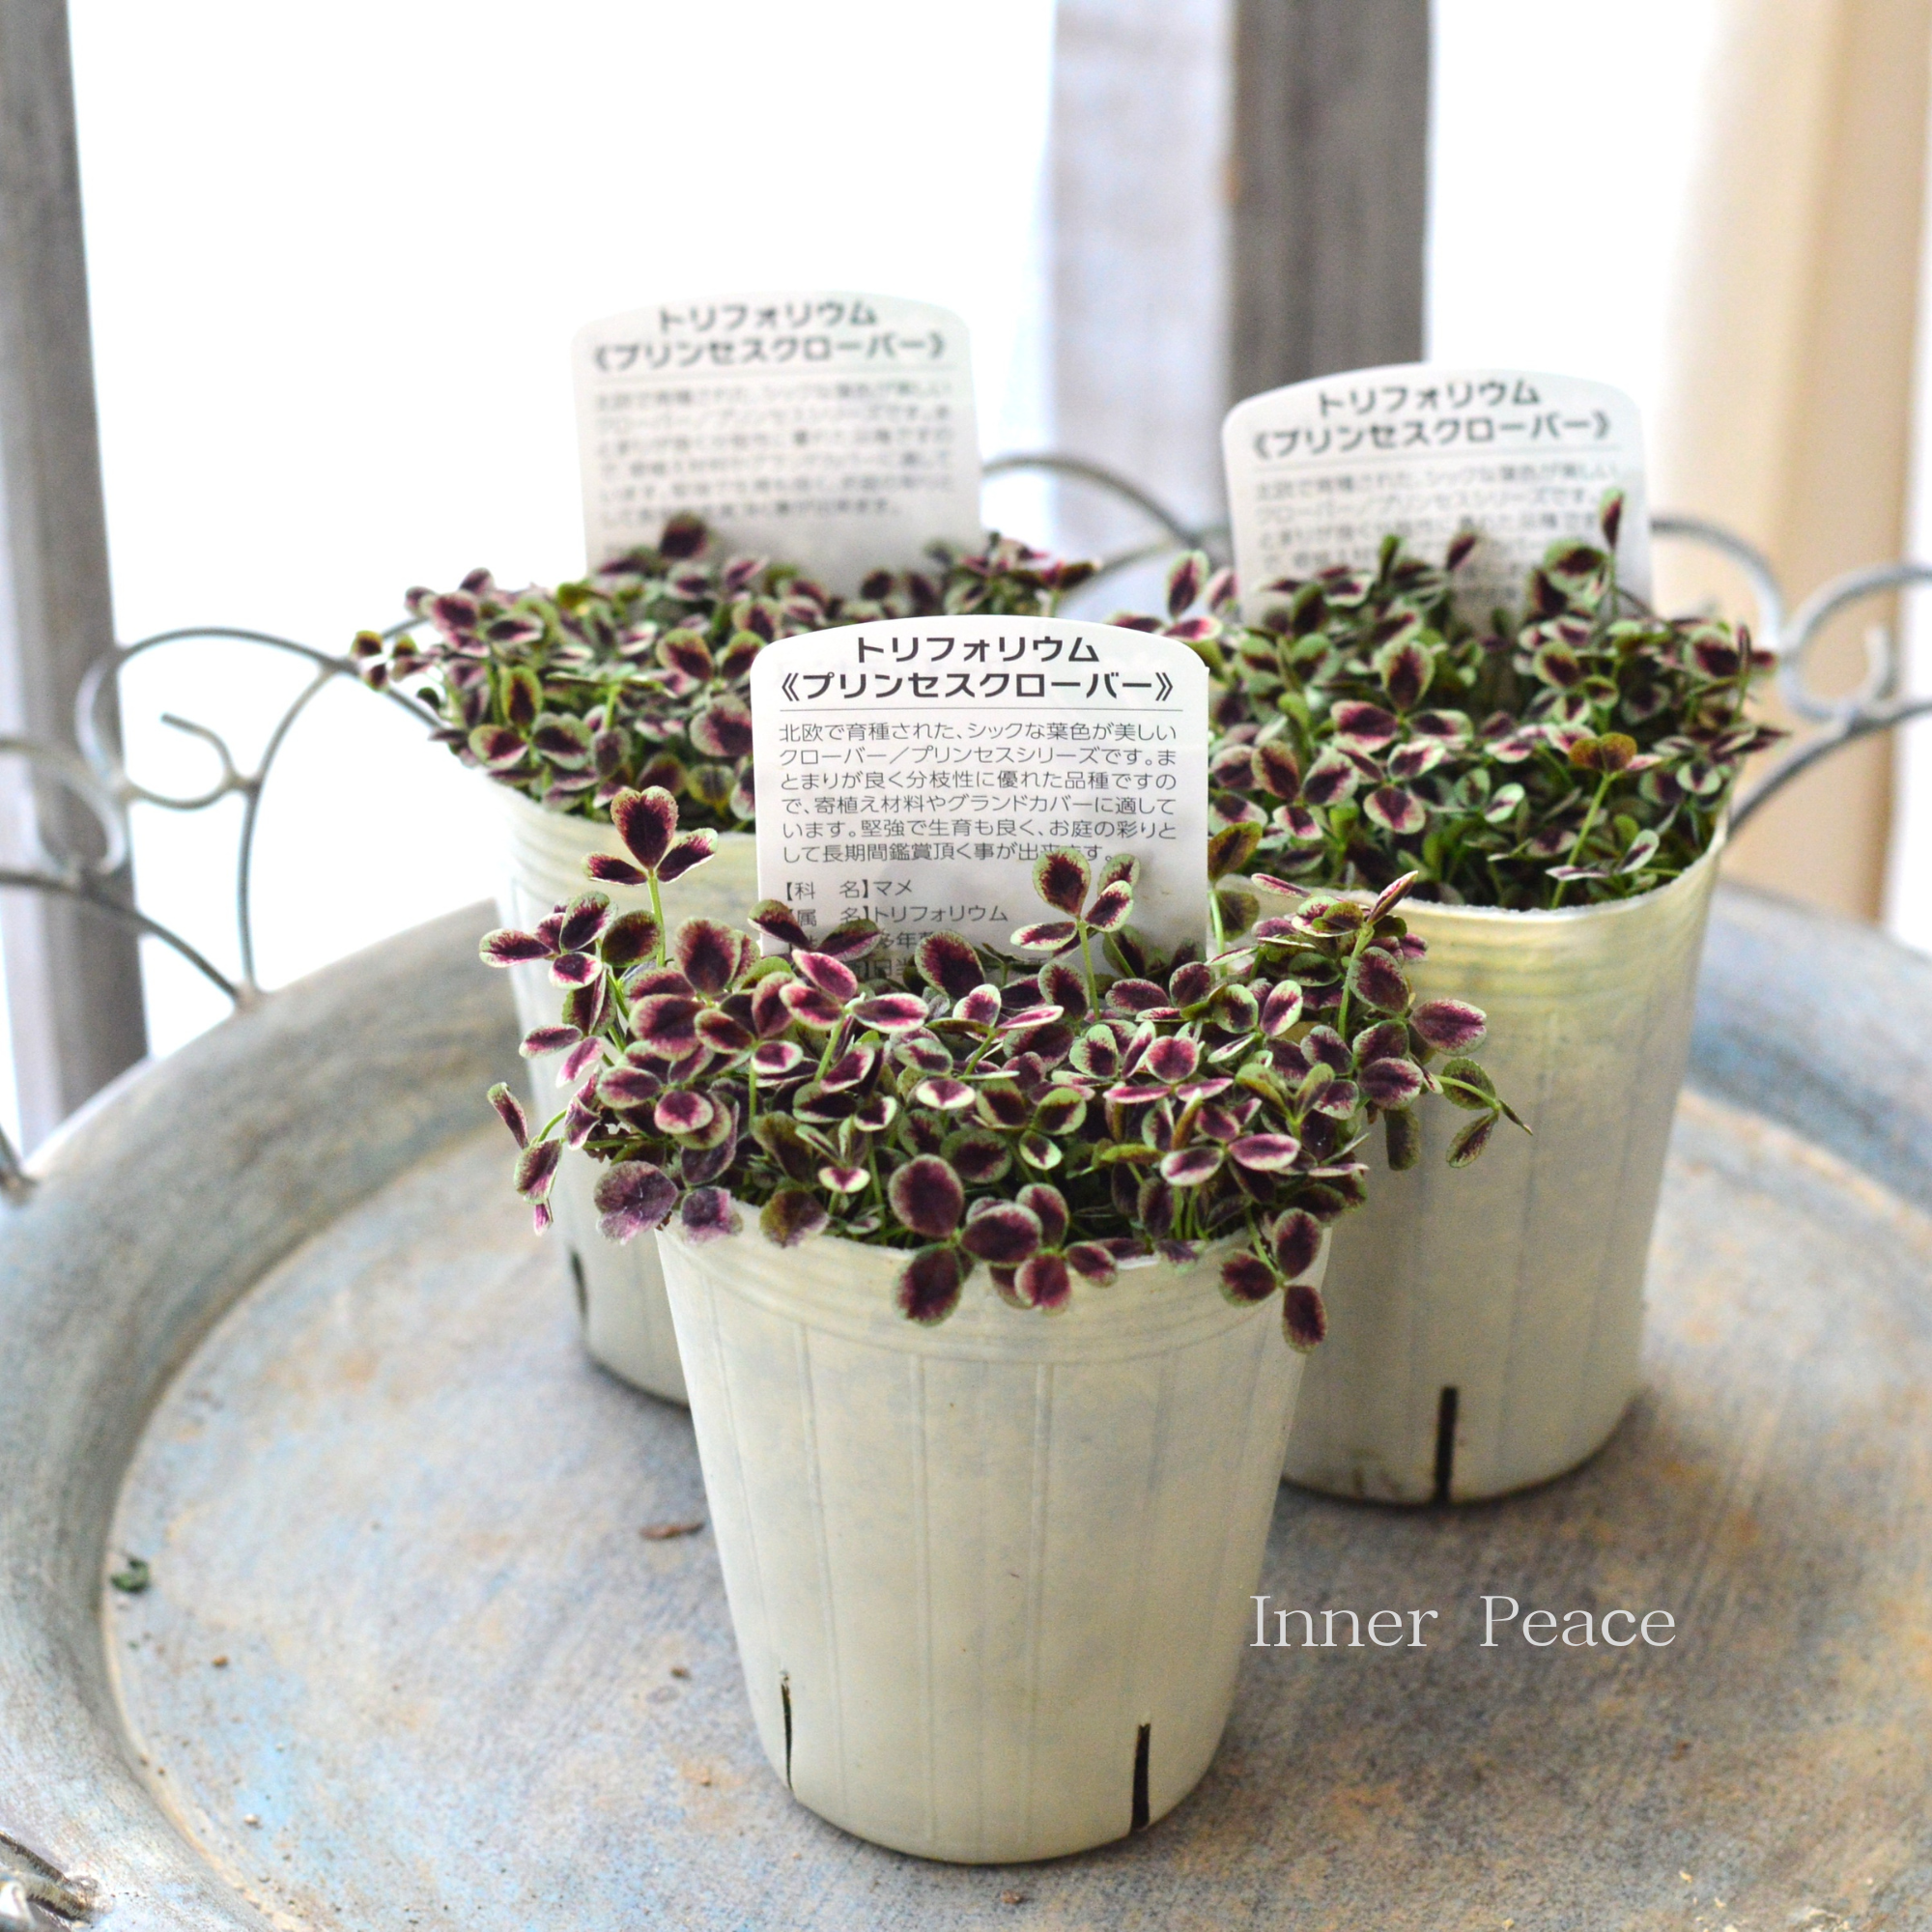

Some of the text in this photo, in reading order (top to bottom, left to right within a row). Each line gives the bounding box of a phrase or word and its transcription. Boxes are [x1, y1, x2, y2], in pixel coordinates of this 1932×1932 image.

[659, 298, 877, 332] トリフォリウム
[1319, 378, 1541, 416] トリフォリウム
[857, 636, 1099, 664] トリフォリウム
[781, 671, 1174, 702] 《プリンセスクローバー》
[779, 722, 1177, 743] 北欧で育種された、シックな葉色が美しい
[780, 771, 1177, 791] とまりが良く分枝性に優れた品種ですの
[783, 795, 1177, 815] で、寄植え材料やグランドカバーに適して
[782, 818, 1178, 840] います。堅強で生育も良く、お庭の彩りと
[782, 841, 1114, 864] して長期間鑑賞頂く事が出す。
